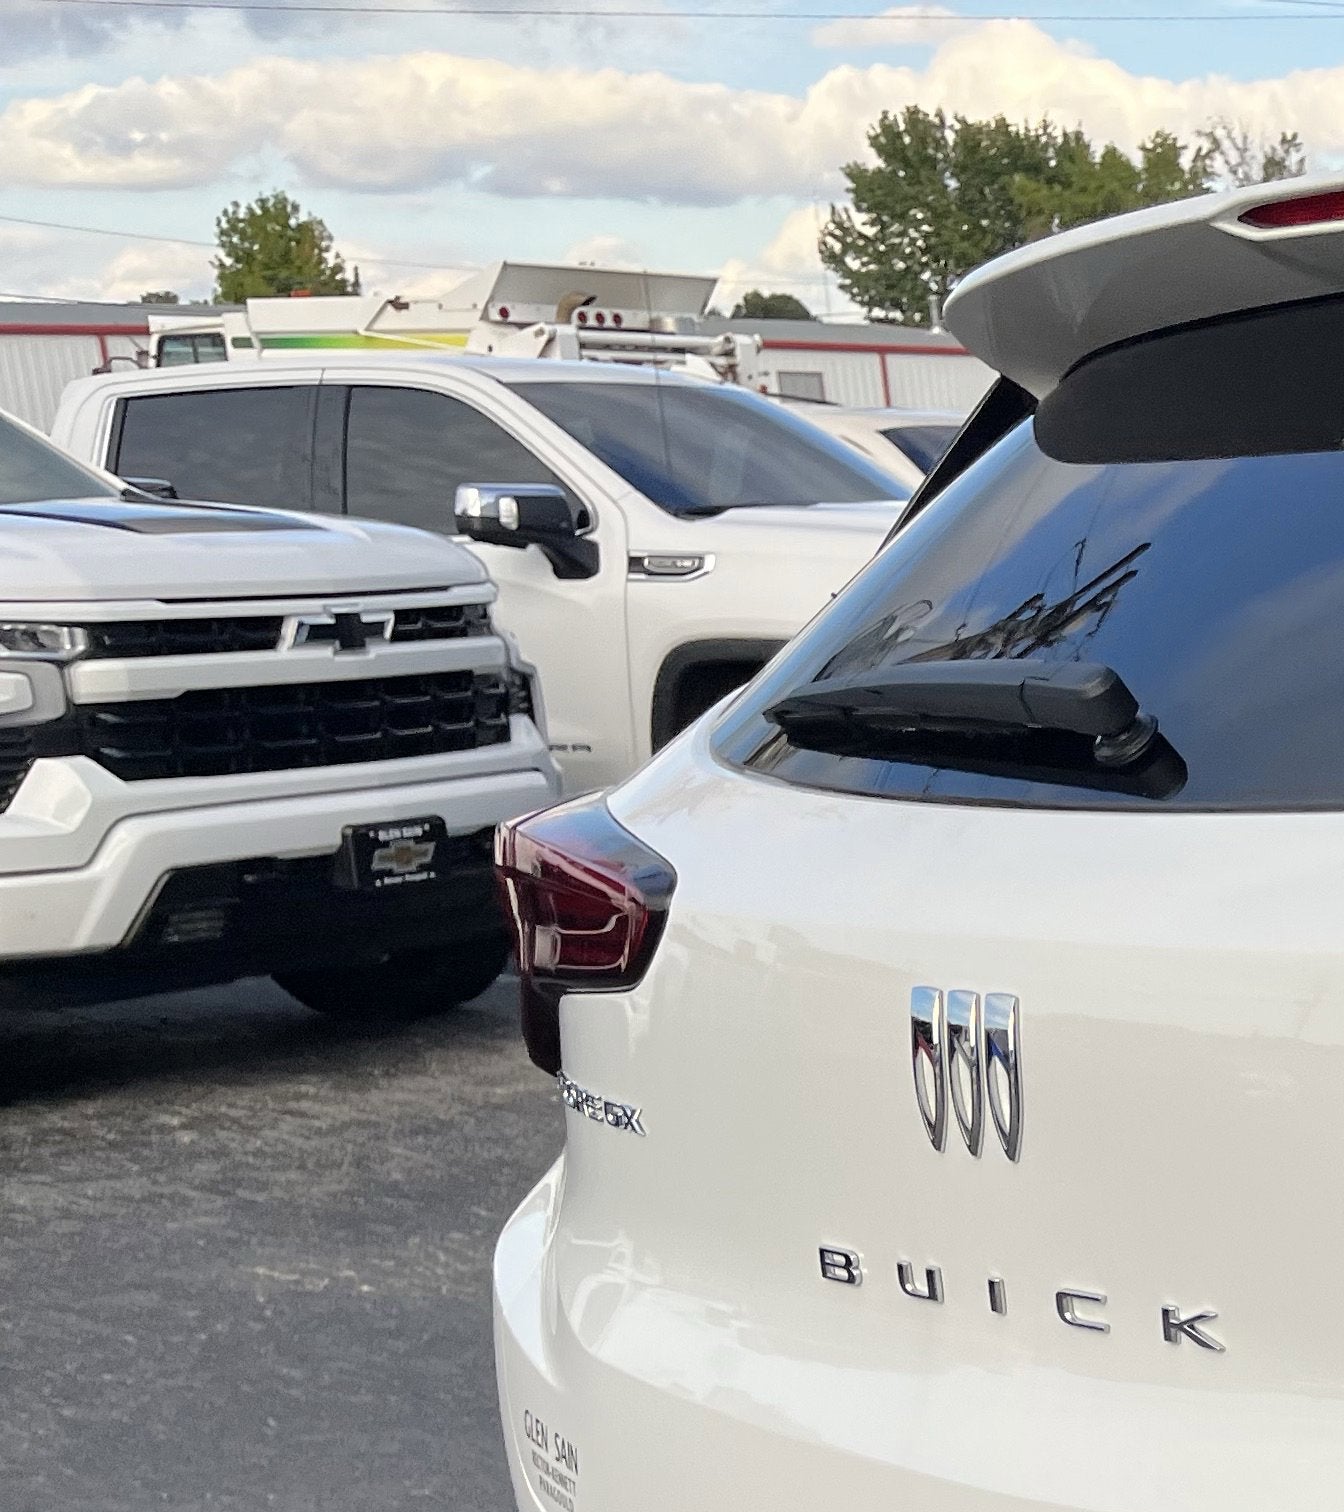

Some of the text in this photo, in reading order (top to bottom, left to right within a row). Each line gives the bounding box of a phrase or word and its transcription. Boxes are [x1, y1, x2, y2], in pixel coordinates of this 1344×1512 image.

[818, 1245, 1226, 1352] BUICK
[524, 1409, 578, 1476] GLEN SAIN
